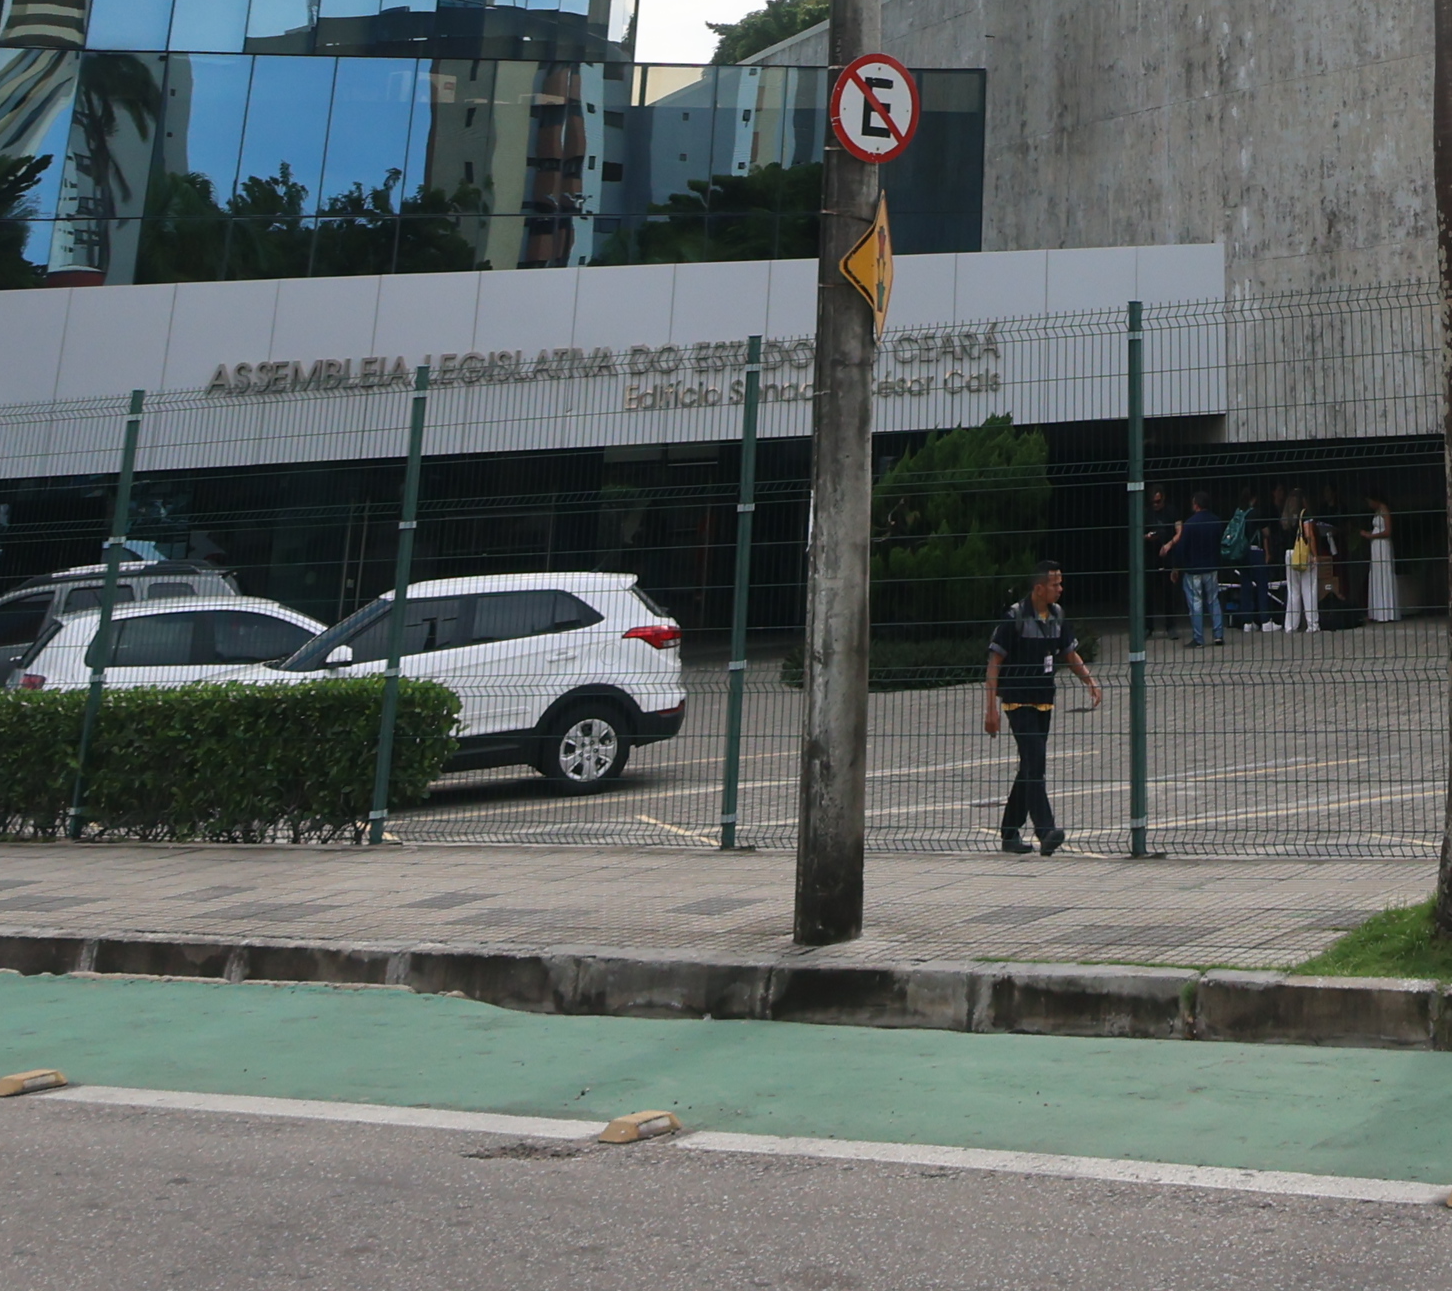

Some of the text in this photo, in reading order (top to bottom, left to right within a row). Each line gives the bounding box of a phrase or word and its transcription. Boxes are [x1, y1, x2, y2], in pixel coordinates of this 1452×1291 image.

[861, 77, 894, 139] E
[207, 355, 415, 395] ASSEMBLEIA
[629, 342, 682, 375] DO
[894, 322, 1001, 364] CEARÁ
[625, 380, 722, 411] Edifício
[871, 370, 935, 398] ésar
[944, 368, 1001, 395] Cals
